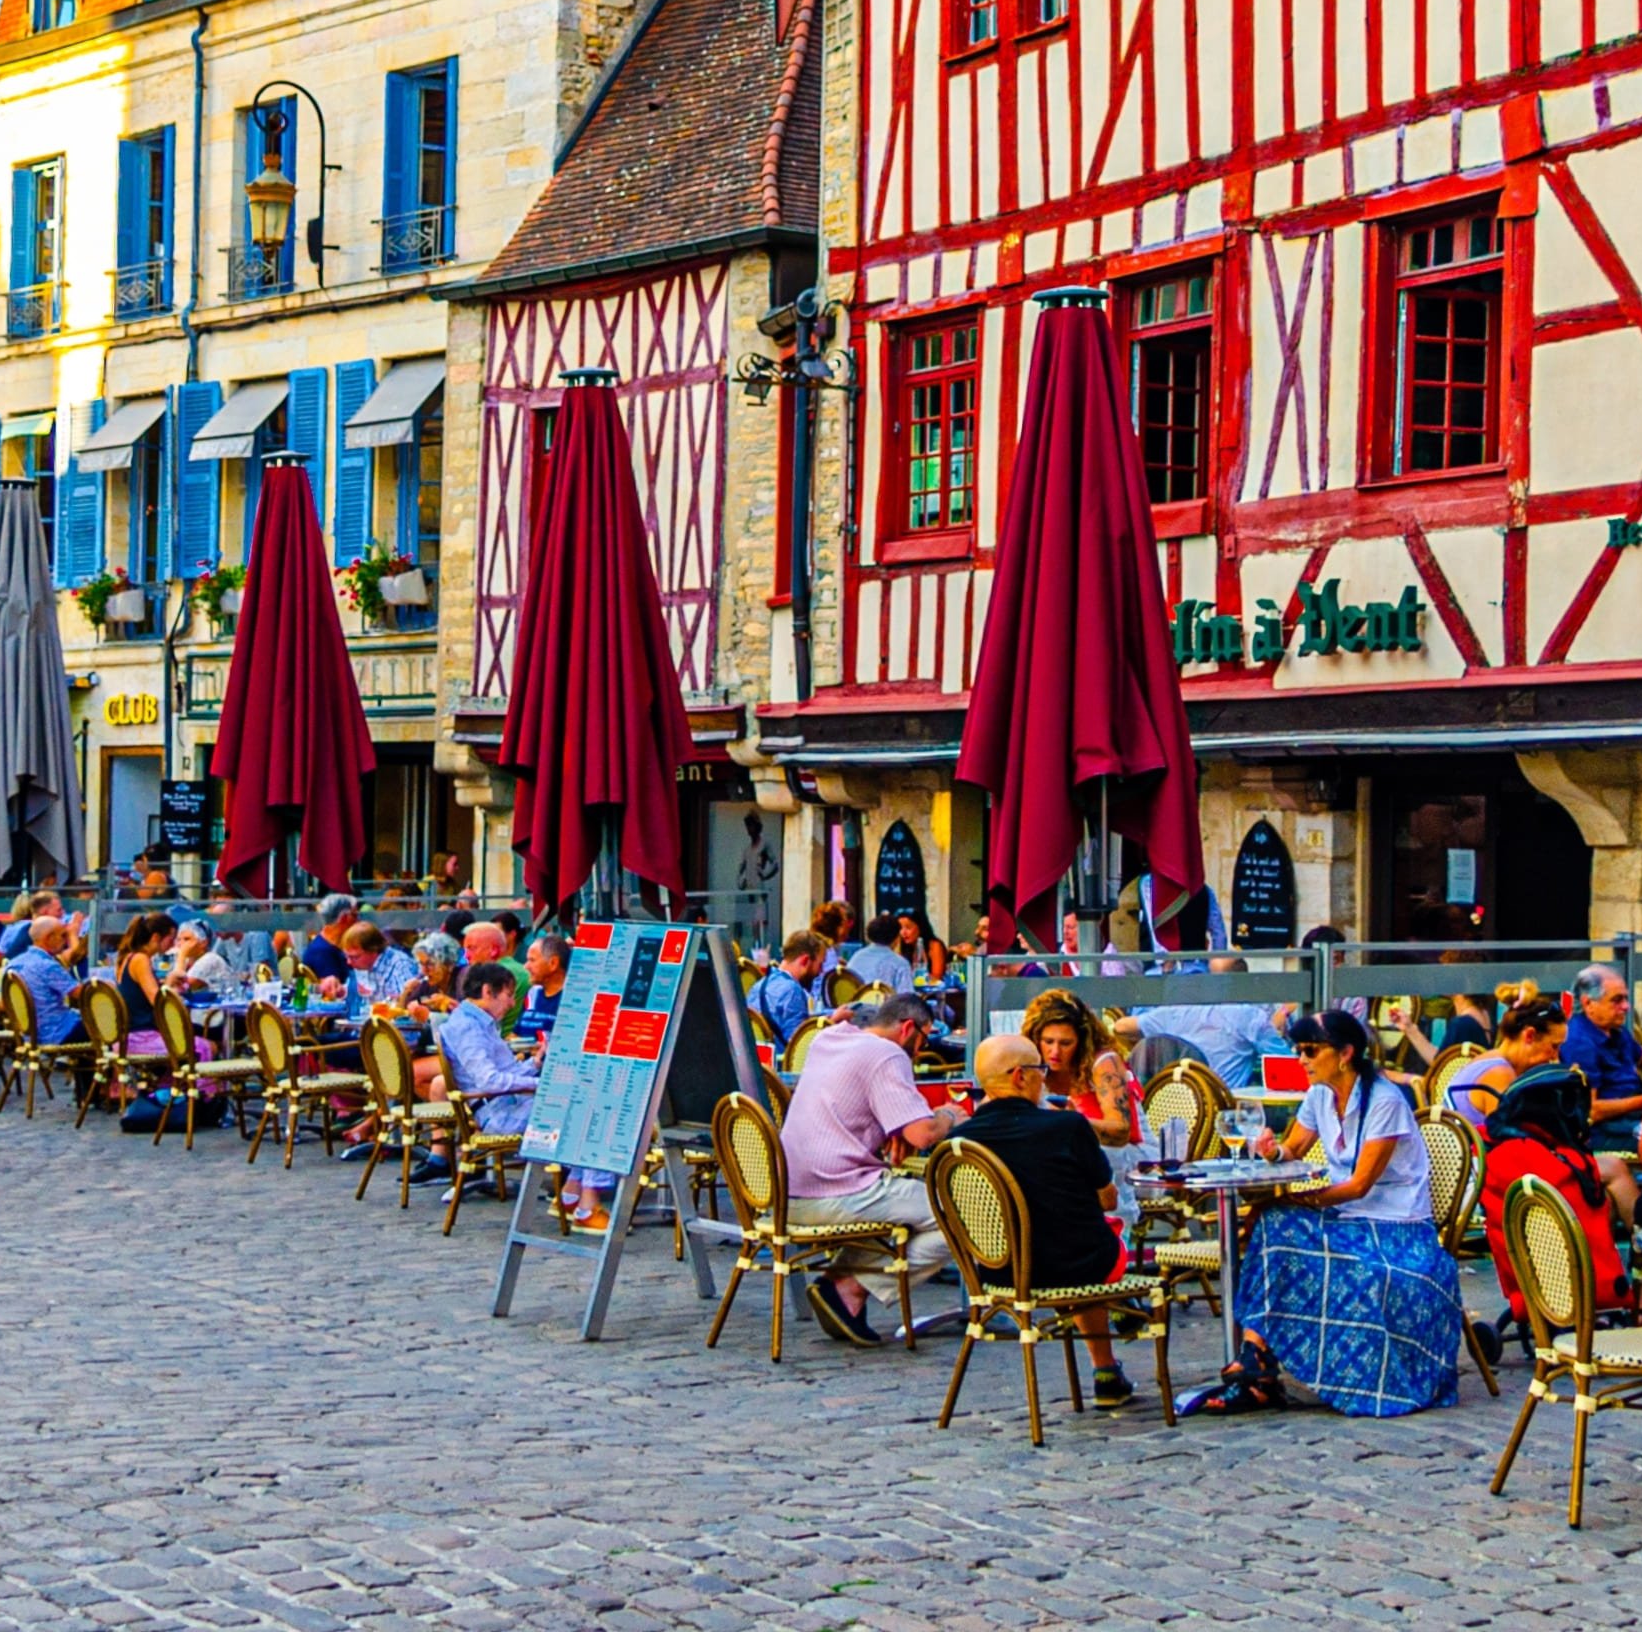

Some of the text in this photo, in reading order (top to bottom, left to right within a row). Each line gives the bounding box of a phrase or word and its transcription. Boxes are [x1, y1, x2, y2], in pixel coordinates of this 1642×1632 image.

[1171, 578, 1426, 663] lin à Vent
[103, 692, 158, 726] CLUB
[675, 763, 713, 782] ant
